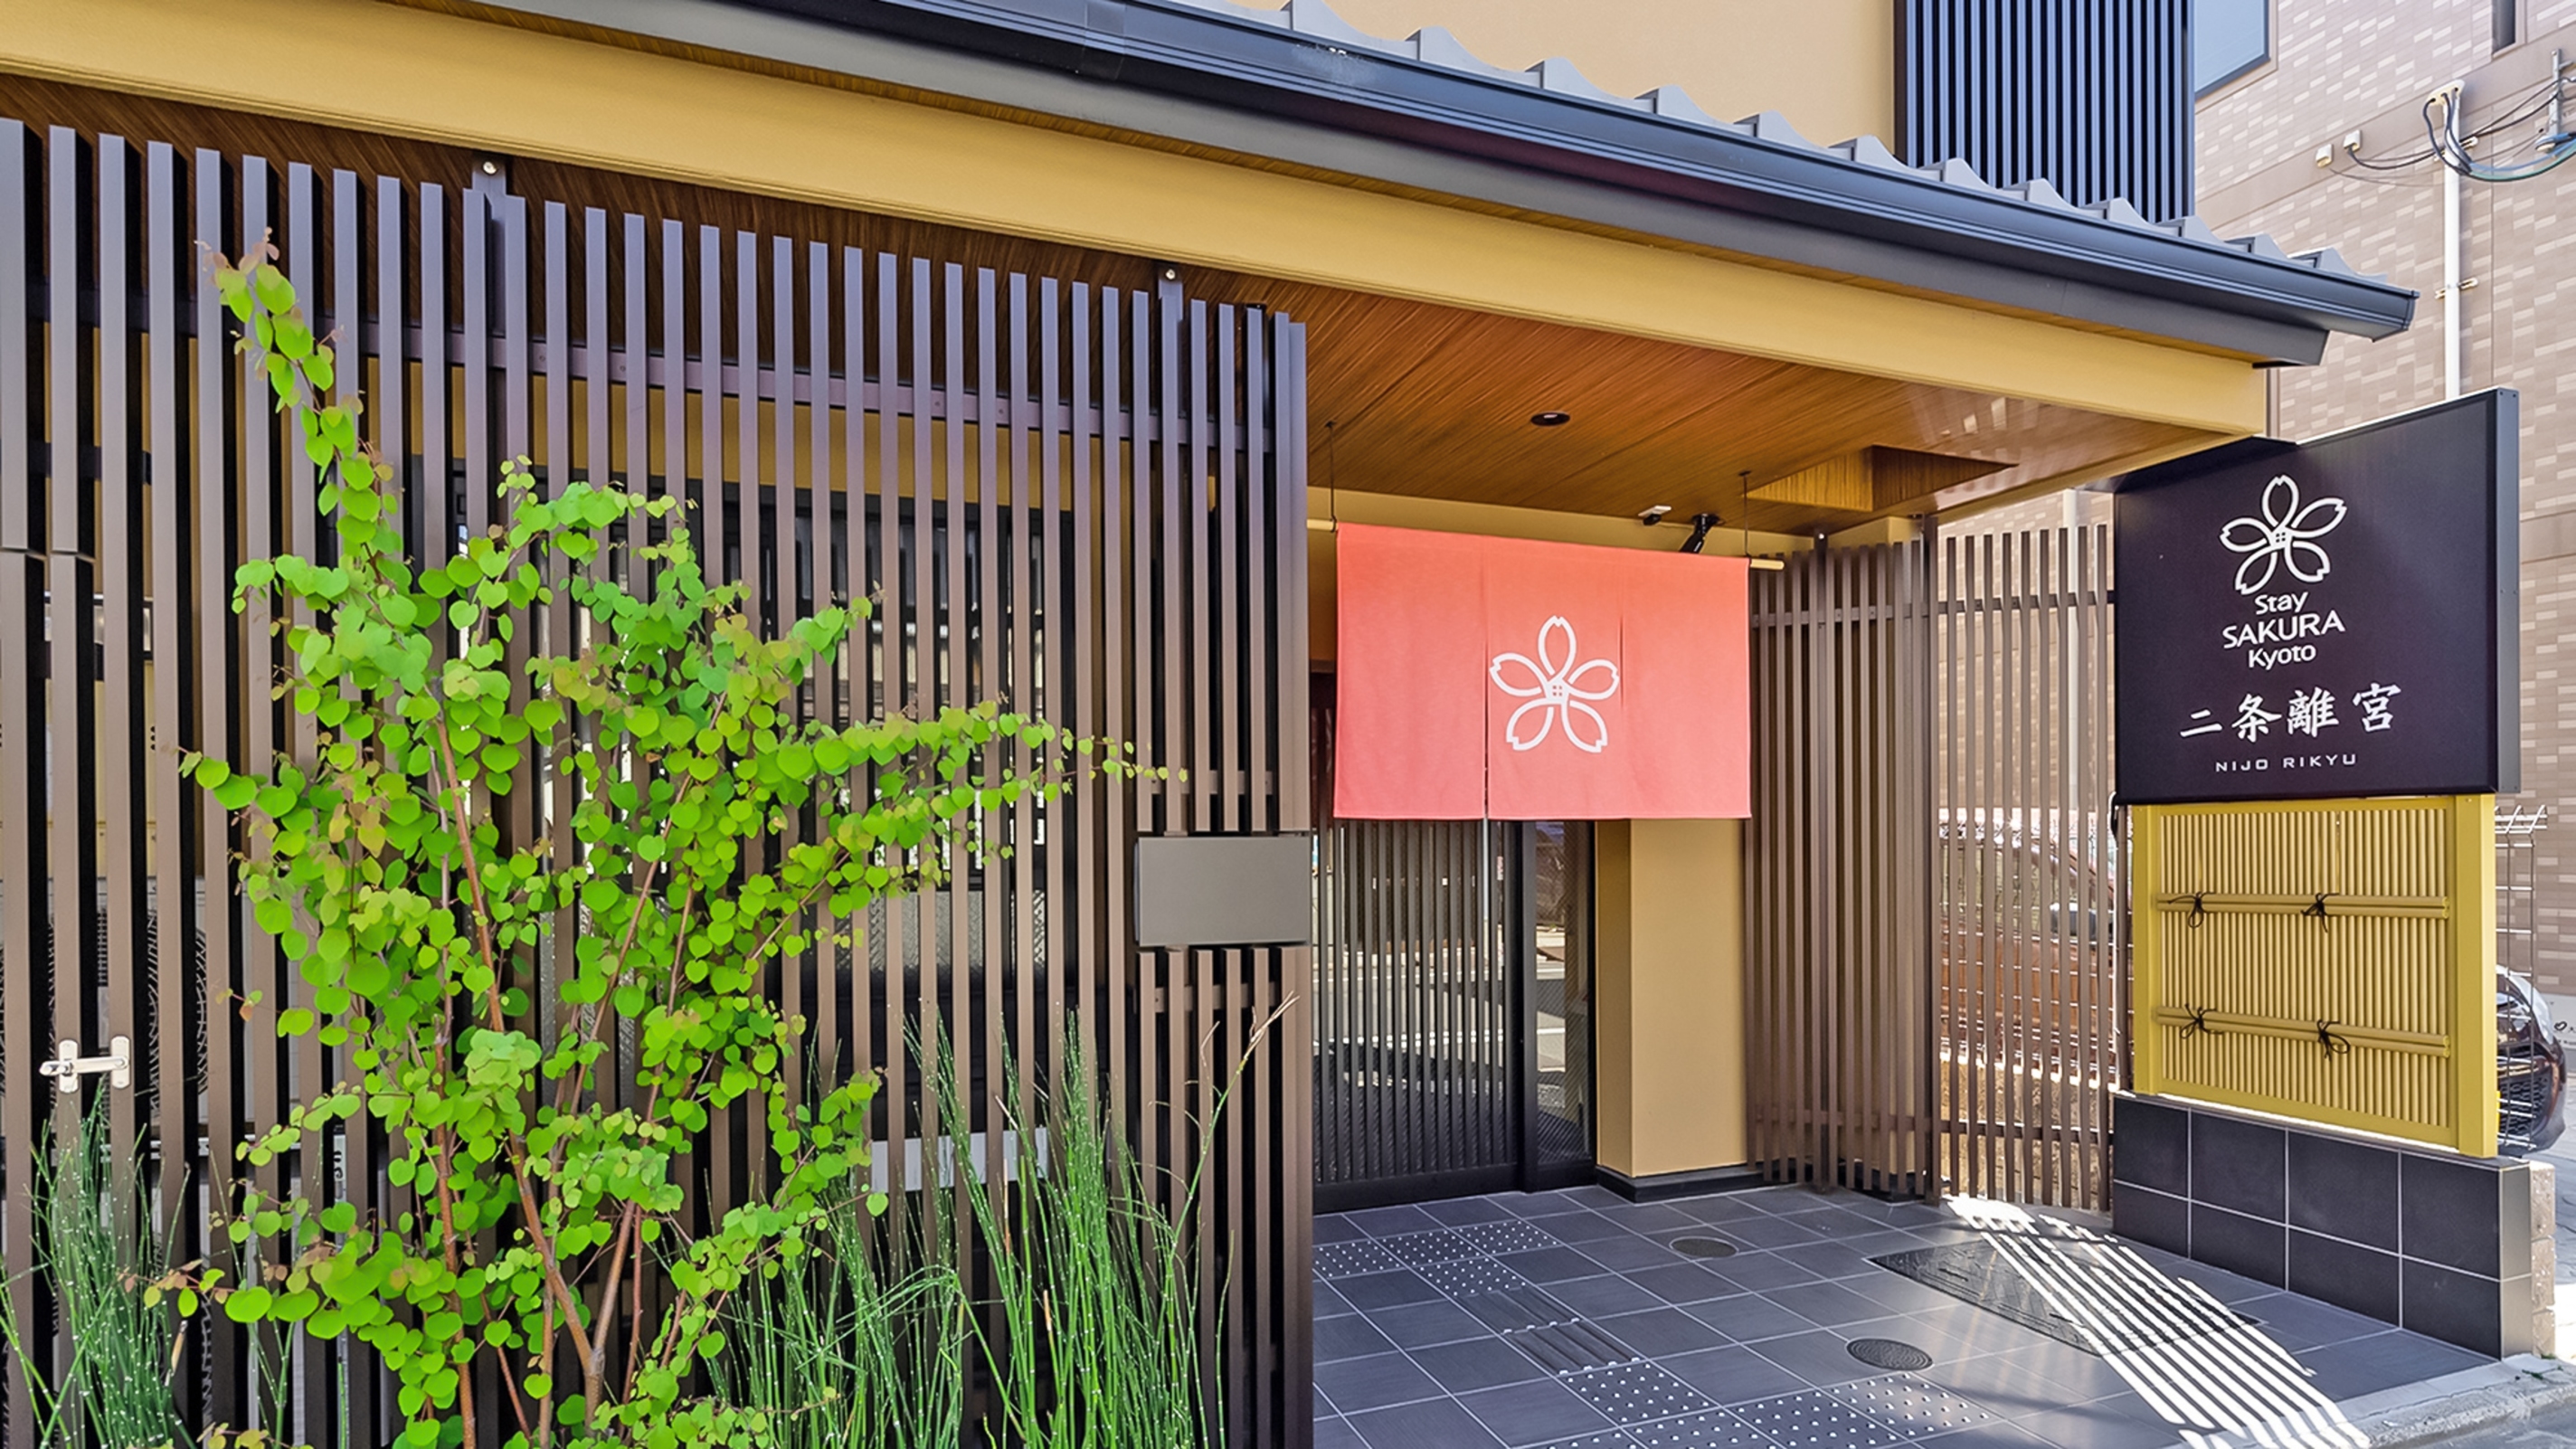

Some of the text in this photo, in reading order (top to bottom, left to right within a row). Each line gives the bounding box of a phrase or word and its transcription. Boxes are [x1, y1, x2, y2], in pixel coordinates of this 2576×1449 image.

[2254, 592, 2308, 615] Stay
[2221, 610, 2345, 649] SAKURA
[2248, 644, 2316, 670] Kyoto
[2180, 682, 2401, 743] 二条離宮
[2215, 753, 2356, 772] NIJO RIKYU
